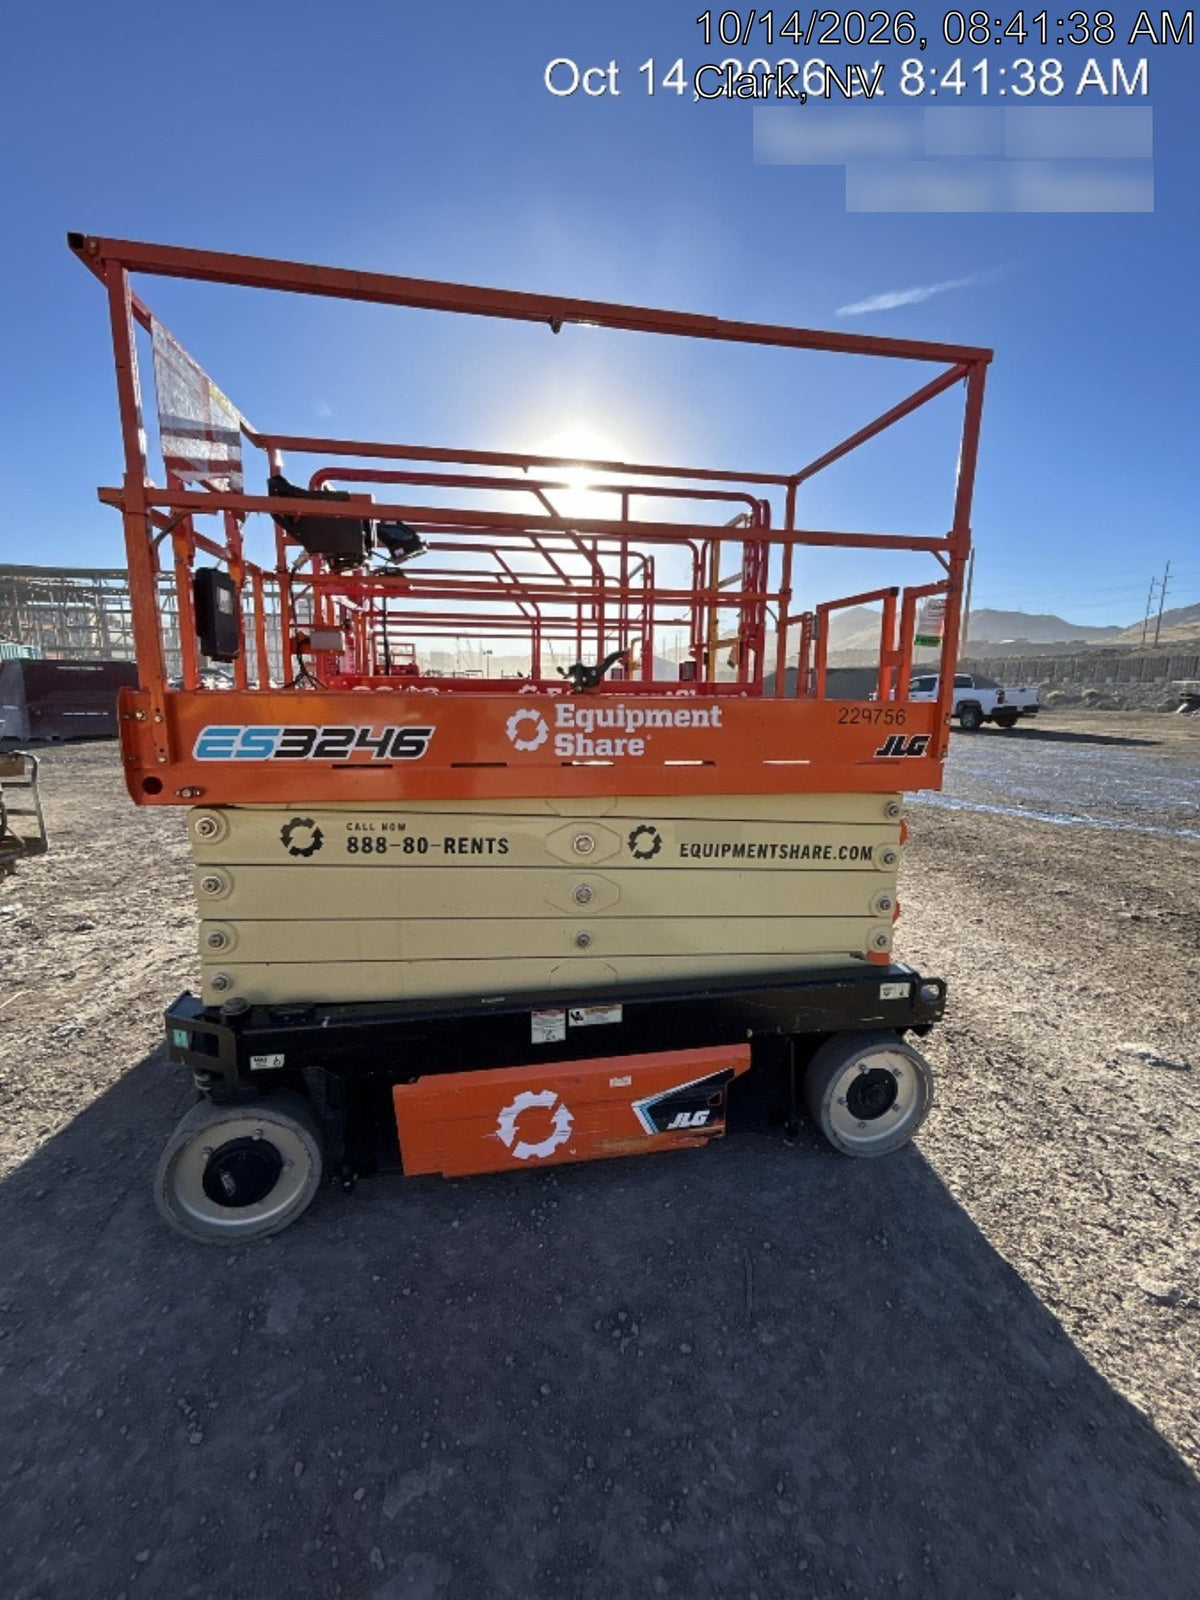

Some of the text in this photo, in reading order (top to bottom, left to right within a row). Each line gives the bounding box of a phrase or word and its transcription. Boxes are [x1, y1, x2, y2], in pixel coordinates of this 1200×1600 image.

[554, 703, 722, 731] Equipment
[837, 707, 906, 726] 229756
[192, 725, 435, 761] ES3246
[873, 734, 932, 758] JLG
[346, 822, 407, 831] CALL NOW
[346, 836, 509, 854] 888-80-RENTS
[680, 842, 873, 861] EQUIPMENTSHARE.COM
[666, 1109, 710, 1130] JLG
